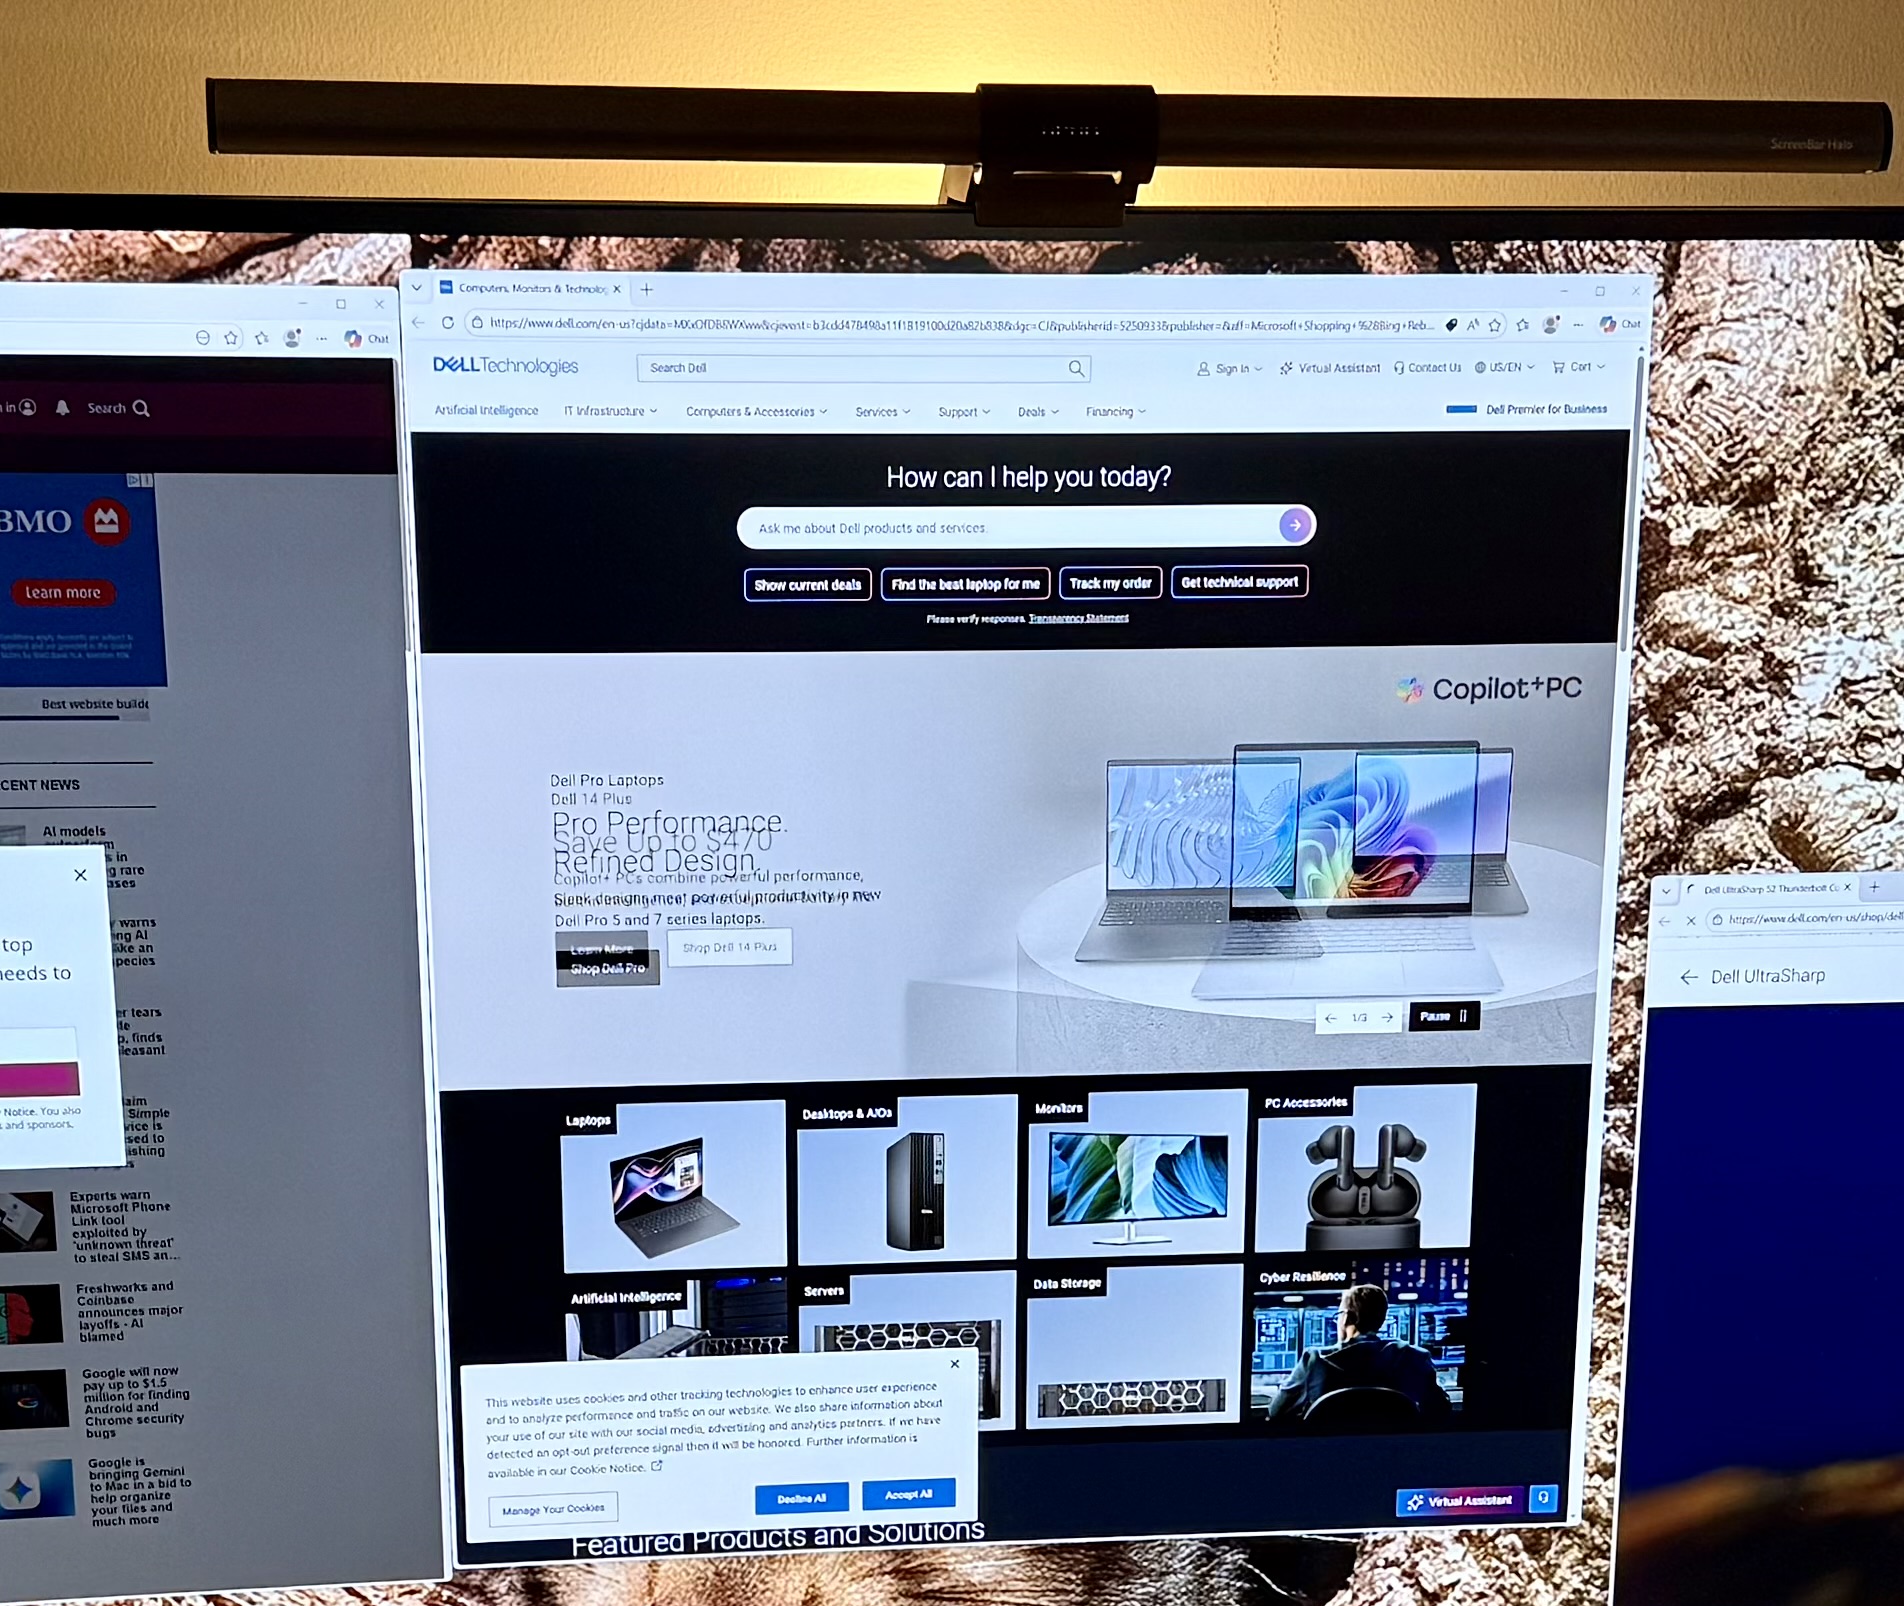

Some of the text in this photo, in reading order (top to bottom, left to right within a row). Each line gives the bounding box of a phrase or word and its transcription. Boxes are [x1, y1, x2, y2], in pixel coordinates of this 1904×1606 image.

[888, 465, 1171, 492] How can I help you today?
[26, 586, 100, 598] Learn more
[41, 779, 80, 790] NEWS
[551, 774, 663, 788] Dell Pro Laptops
[2, 939, 32, 956] top
[53, 967, 71, 980] to
[1712, 968, 1825, 984] Dell UltraSharp
[1036, 1103, 1083, 1114] Monitors
[1265, 1096, 1348, 1108] PC Accessories
[573, 1522, 985, 1557] Featured Products and Solutions
